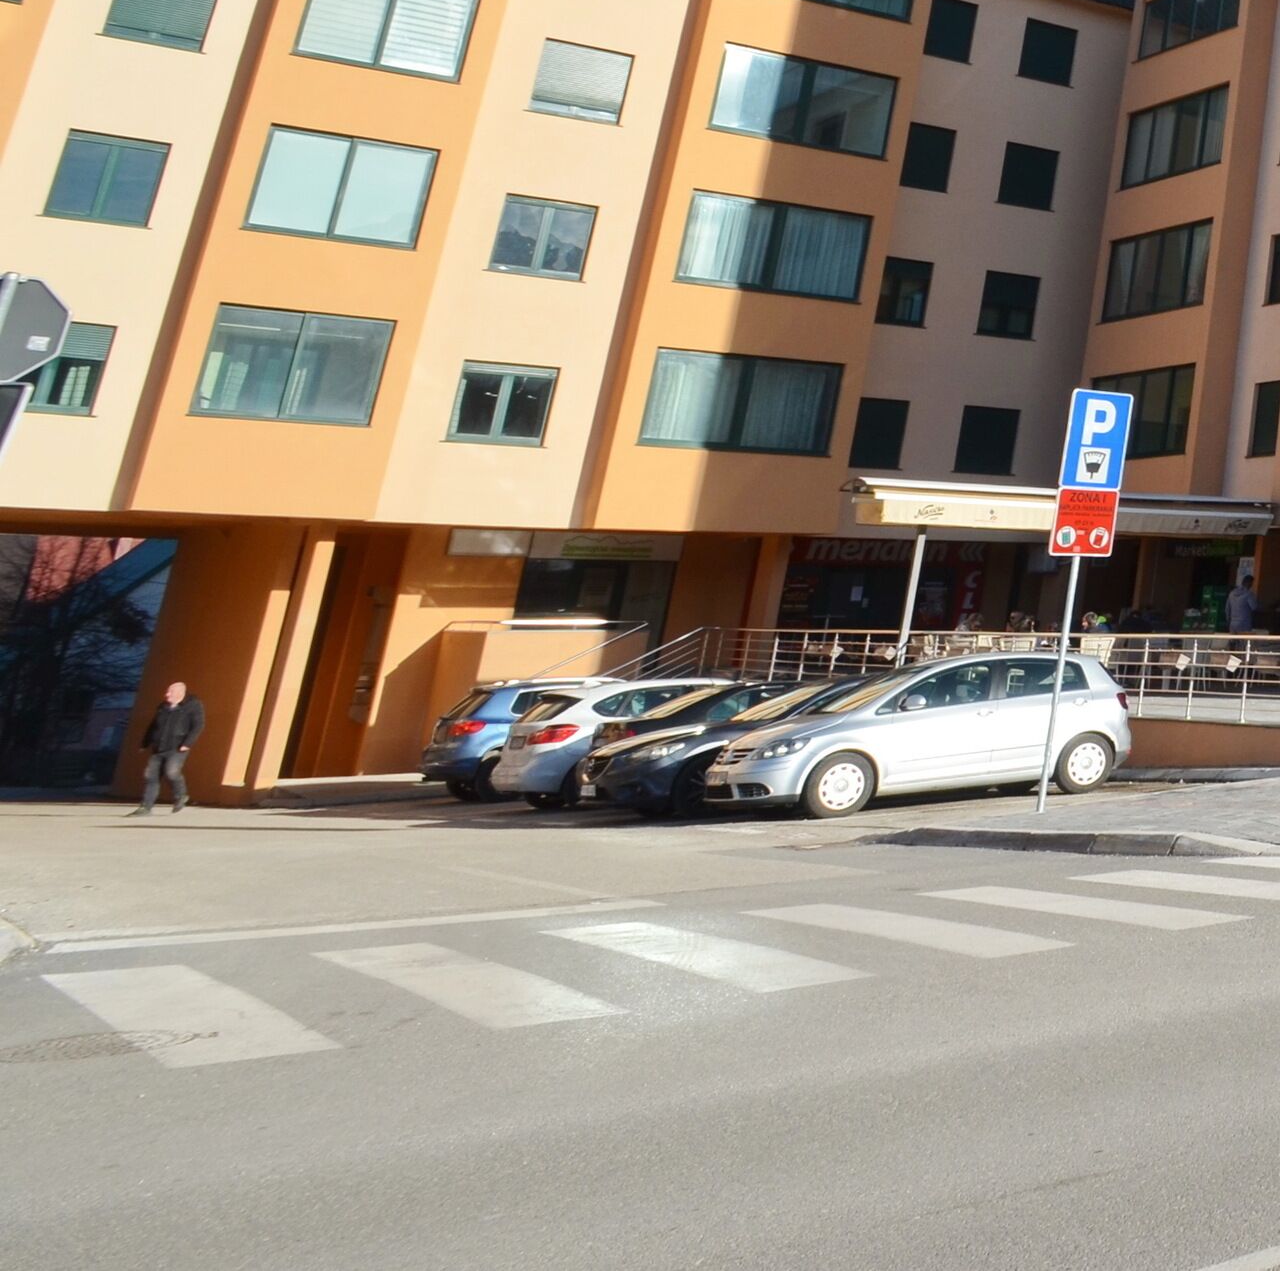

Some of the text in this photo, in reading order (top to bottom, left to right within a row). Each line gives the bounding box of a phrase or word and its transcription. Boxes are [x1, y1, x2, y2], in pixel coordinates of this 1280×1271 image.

[1081, 398, 1117, 446] P
[1070, 492, 1100, 504] ZONA
[806, 538, 948, 562] meridin
